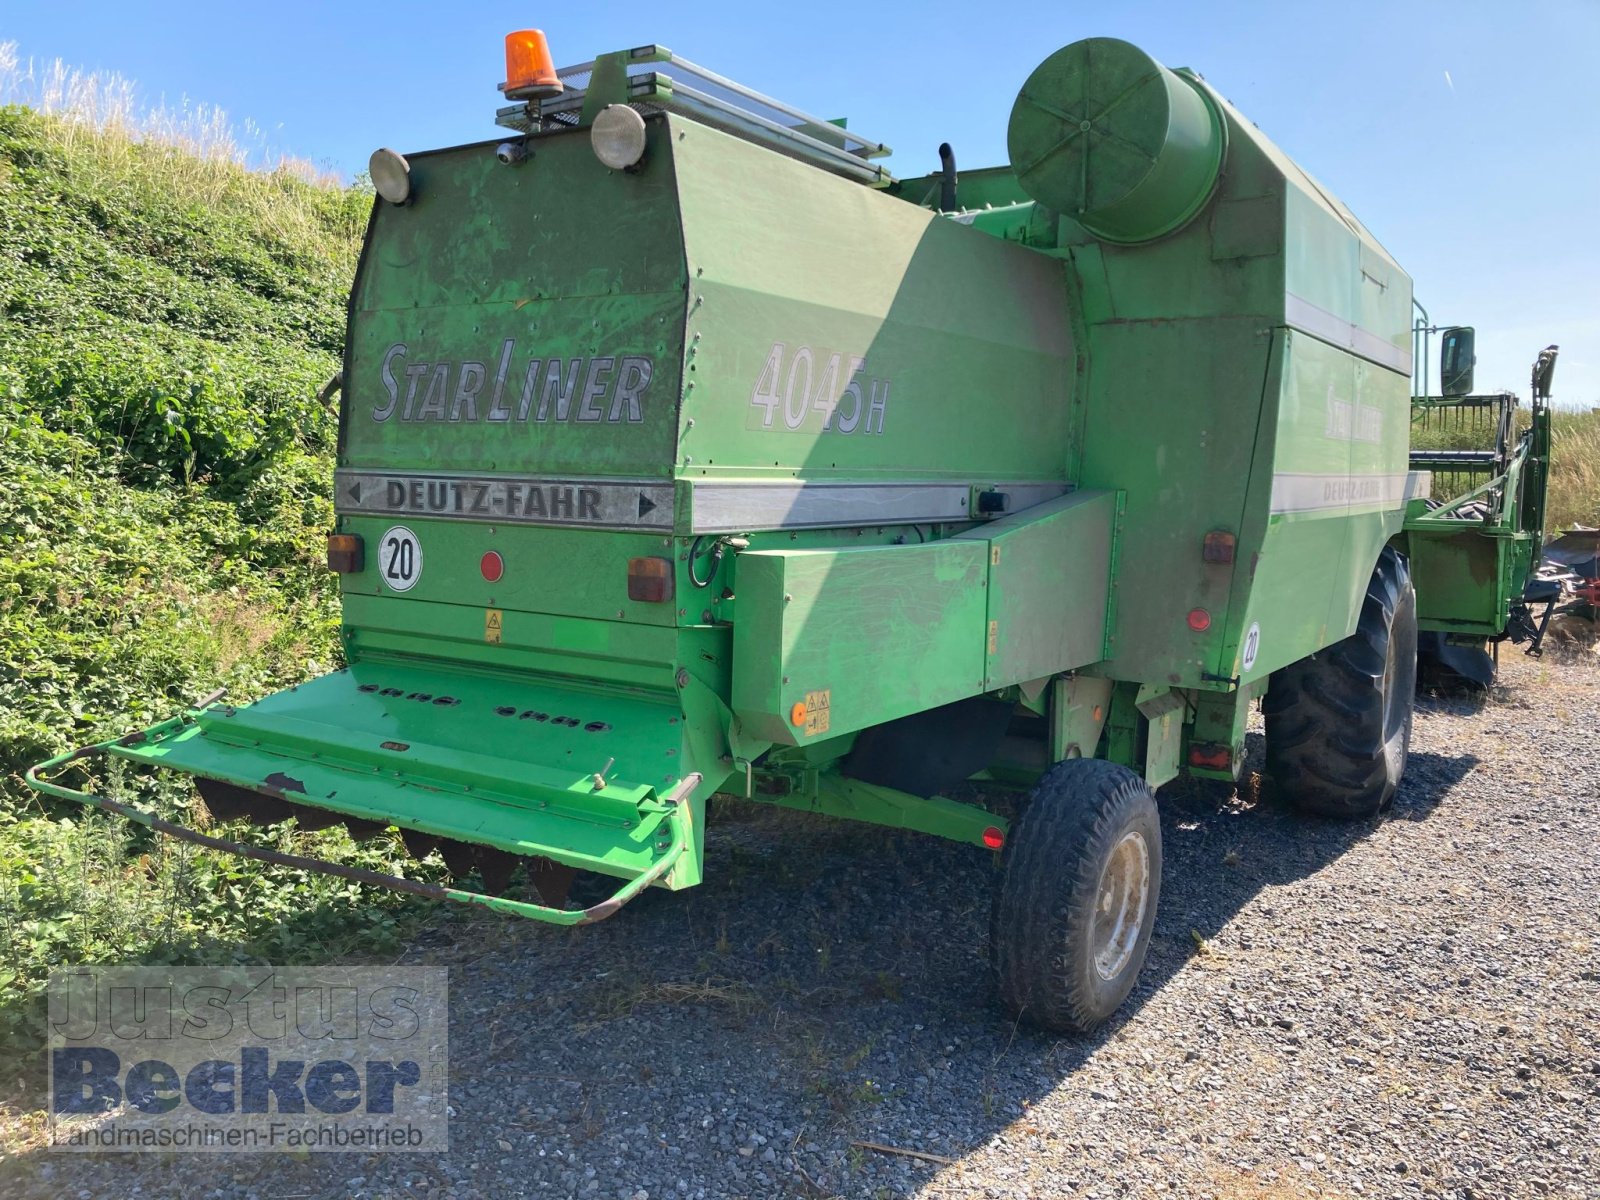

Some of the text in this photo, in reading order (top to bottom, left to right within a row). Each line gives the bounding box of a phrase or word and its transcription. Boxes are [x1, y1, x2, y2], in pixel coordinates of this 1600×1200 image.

[751, 342, 891, 435] 4045H
[386, 481, 602, 520] DEUTZ-FAHR
[387, 537, 413, 580] 20
[1245, 631, 1258, 664] 20
